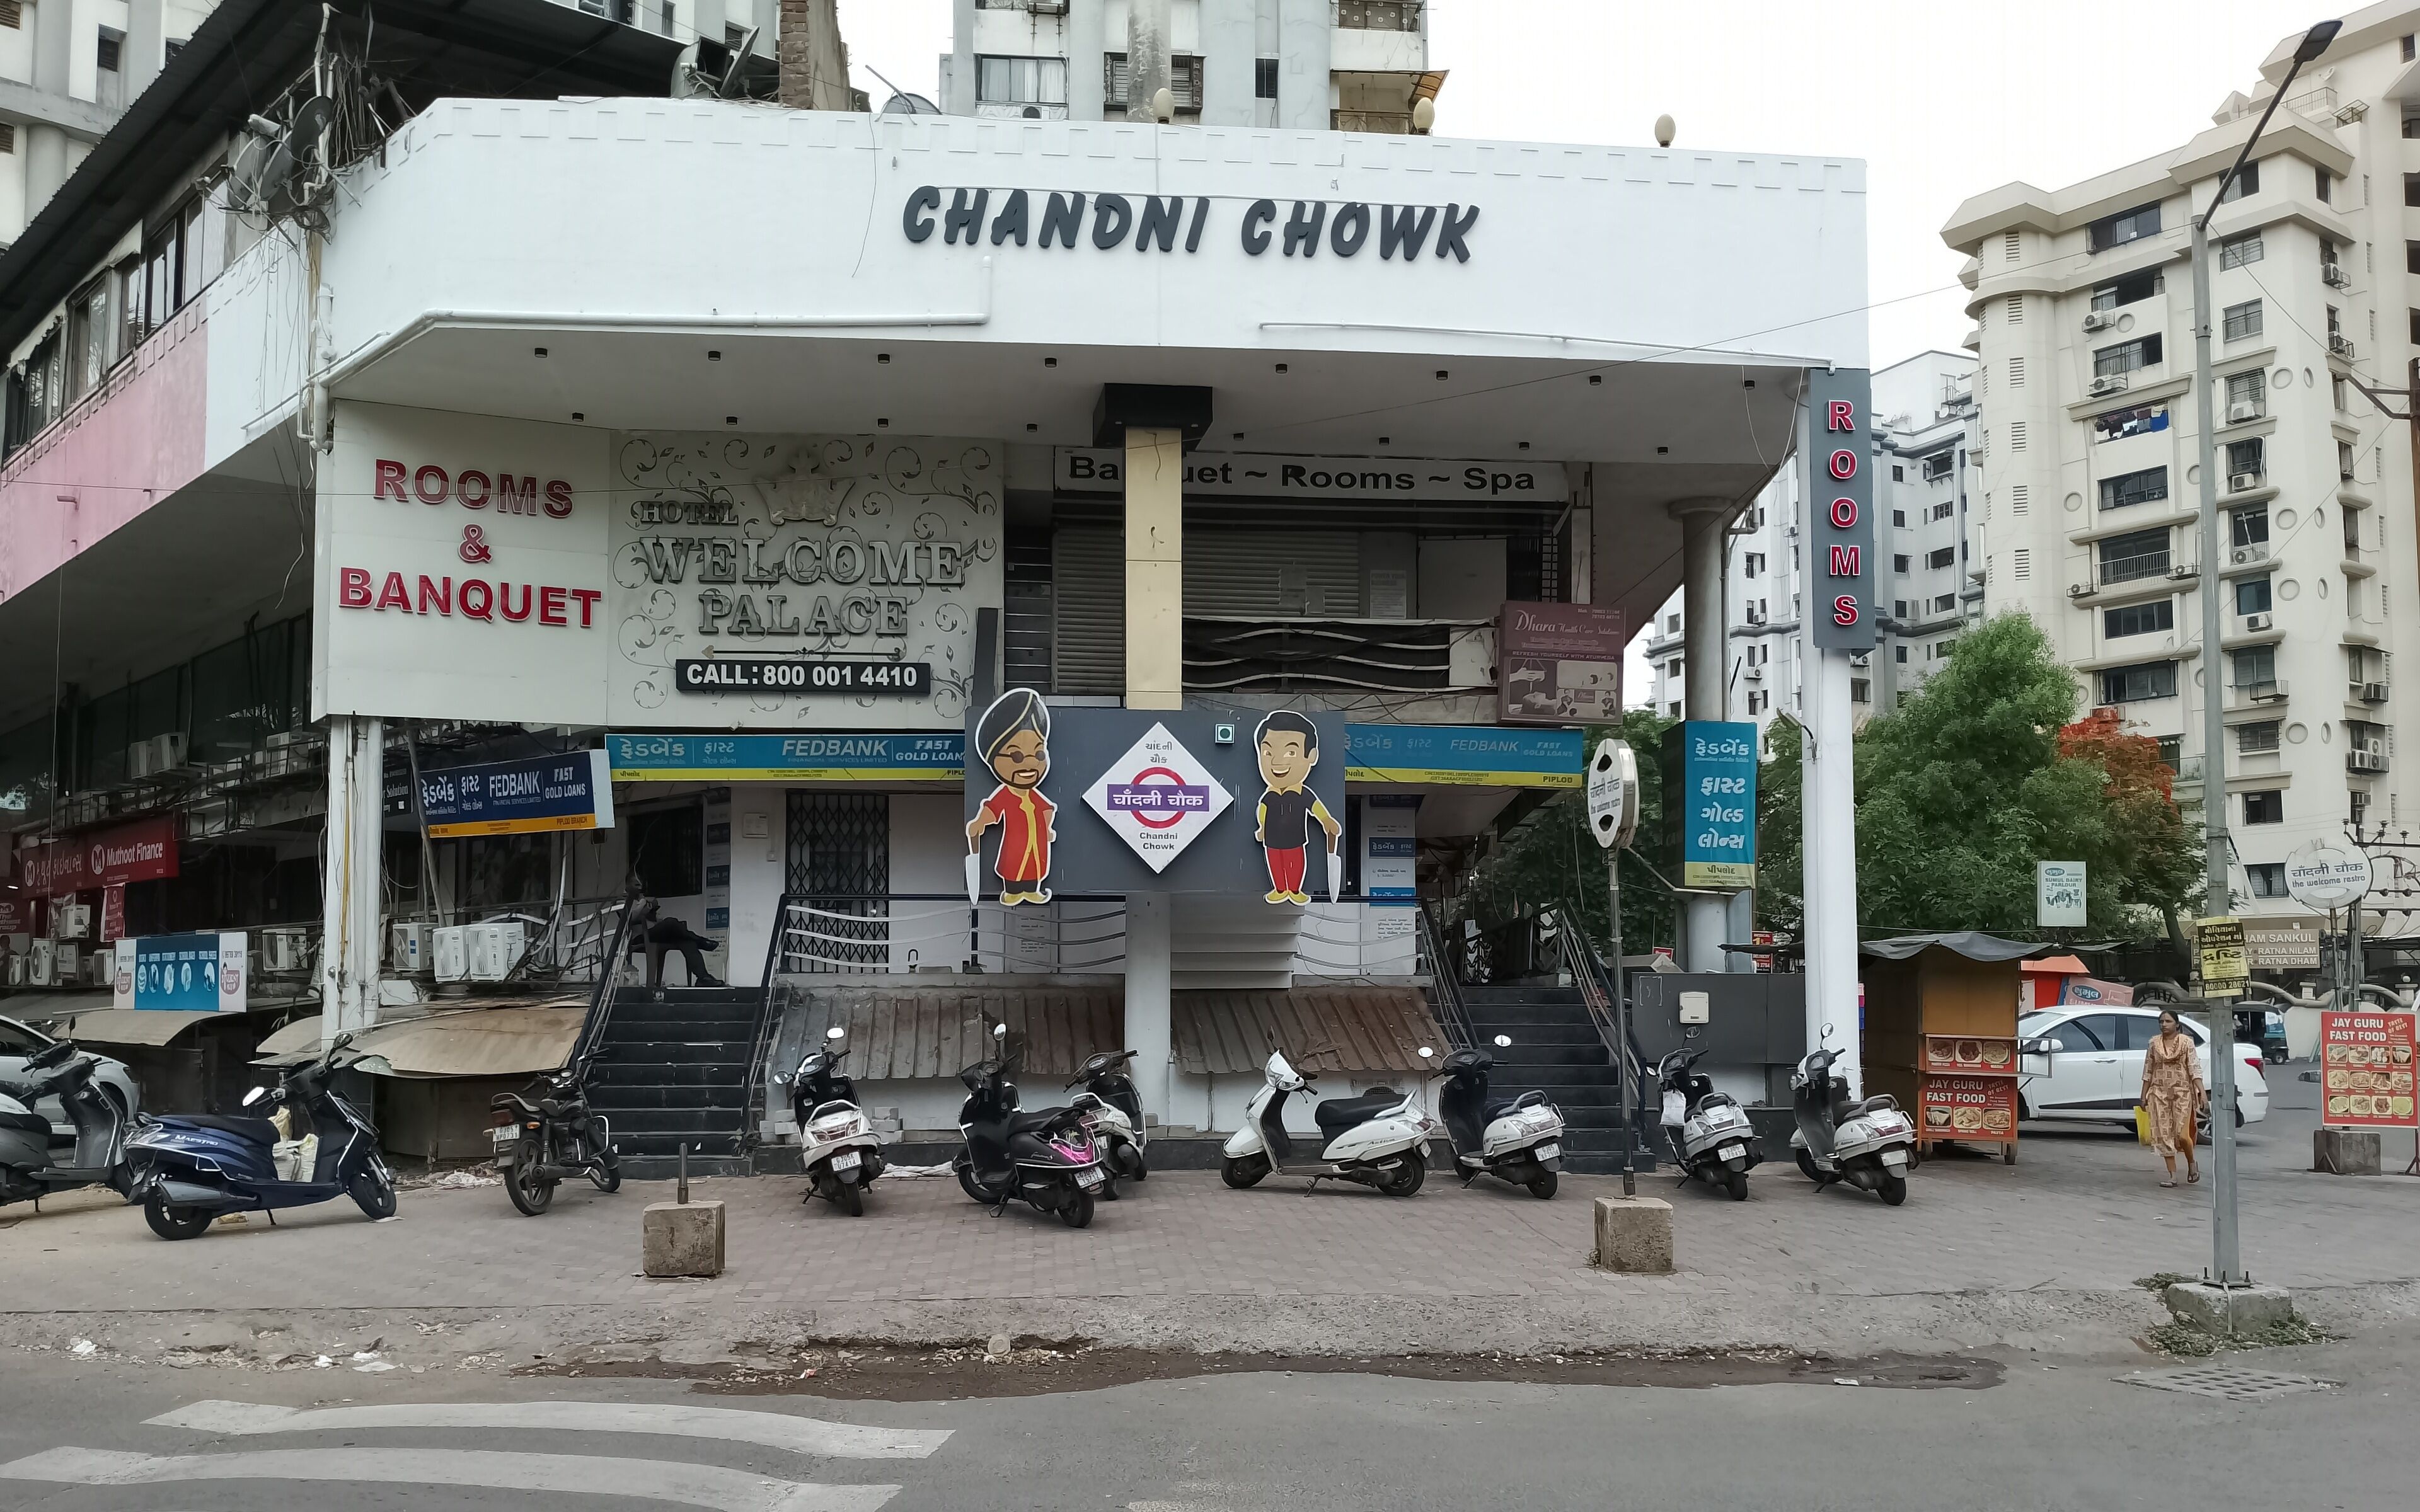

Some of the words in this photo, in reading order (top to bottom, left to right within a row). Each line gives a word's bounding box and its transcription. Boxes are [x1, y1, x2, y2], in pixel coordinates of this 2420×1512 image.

[902, 185, 1210, 254] CHANDNI
[1241, 199, 1480, 263] CHOWK
[1069, 455, 1233, 484] Bauet
[1281, 466, 1416, 491] Rooms
[1463, 467, 1535, 496] Spa
[373, 459, 573, 520] ROOMS
[640, 500, 739, 527] HOTEL
[1828, 399, 1860, 626] ROOMS
[458, 522, 493, 564] &
[640, 536, 966, 587] WELCOME
[338, 566, 602, 629] BANQUET
[699, 592, 908, 637] PALACE
[1514, 610, 1555, 633] Dhara
[812, 665, 851, 685] 001
[860, 666, 917, 687] 4410
[781, 740, 889, 757] FEDBANK
[914, 740, 952, 750] FAST
[1144, 740, 1173, 752] ચાંદની
[1450, 740, 1519, 752] FEDBANK
[896, 752, 928, 761] GOLD
[554, 767, 573, 782] FAST
[1543, 776, 1573, 784] PIPLOD
[386, 782, 409, 798] Solution
[489, 771, 540, 798] FEDBANK
[545, 786, 563, 799] GOLD
[564, 784, 586, 797] LOANS
[1700, 777, 1746, 797] ફાસ્ટ
[1112, 788, 1162, 806] चाँदनी
[1167, 789, 1204, 807] चौक
[1700, 801, 1744, 823] ગોલ્ડ
[1139, 832, 1178, 840] Chandni
[1698, 828, 1745, 849] લોન્સ
[107, 845, 135, 866] Muthoot
[136, 842, 163, 862] Finance
[1143, 842, 1175, 850] Chowk
[2290, 862, 2330, 878] चाँदनी
[2334, 860, 2363, 873] चौक
[2307, 878, 2341, 886] welcome
[2343, 875, 2366, 883] restro
[2269, 933, 2316, 943] SANKUL
[2258, 947, 2286, 955] RATNA
[2289, 947, 2317, 955] NILAM
[2331, 1018, 2351, 1028] JAY
[2354, 1018, 2383, 1028] GURU
[2330, 1031, 2355, 1041] FAST
[2358, 1032, 2387, 1041] FOOD
[1929, 1079, 1949, 1089] JAY
[1952, 1080, 1983, 1090] GURU
[1927, 1092, 1953, 1102] FAST
[1956, 1094, 1986, 1103] FOOD
